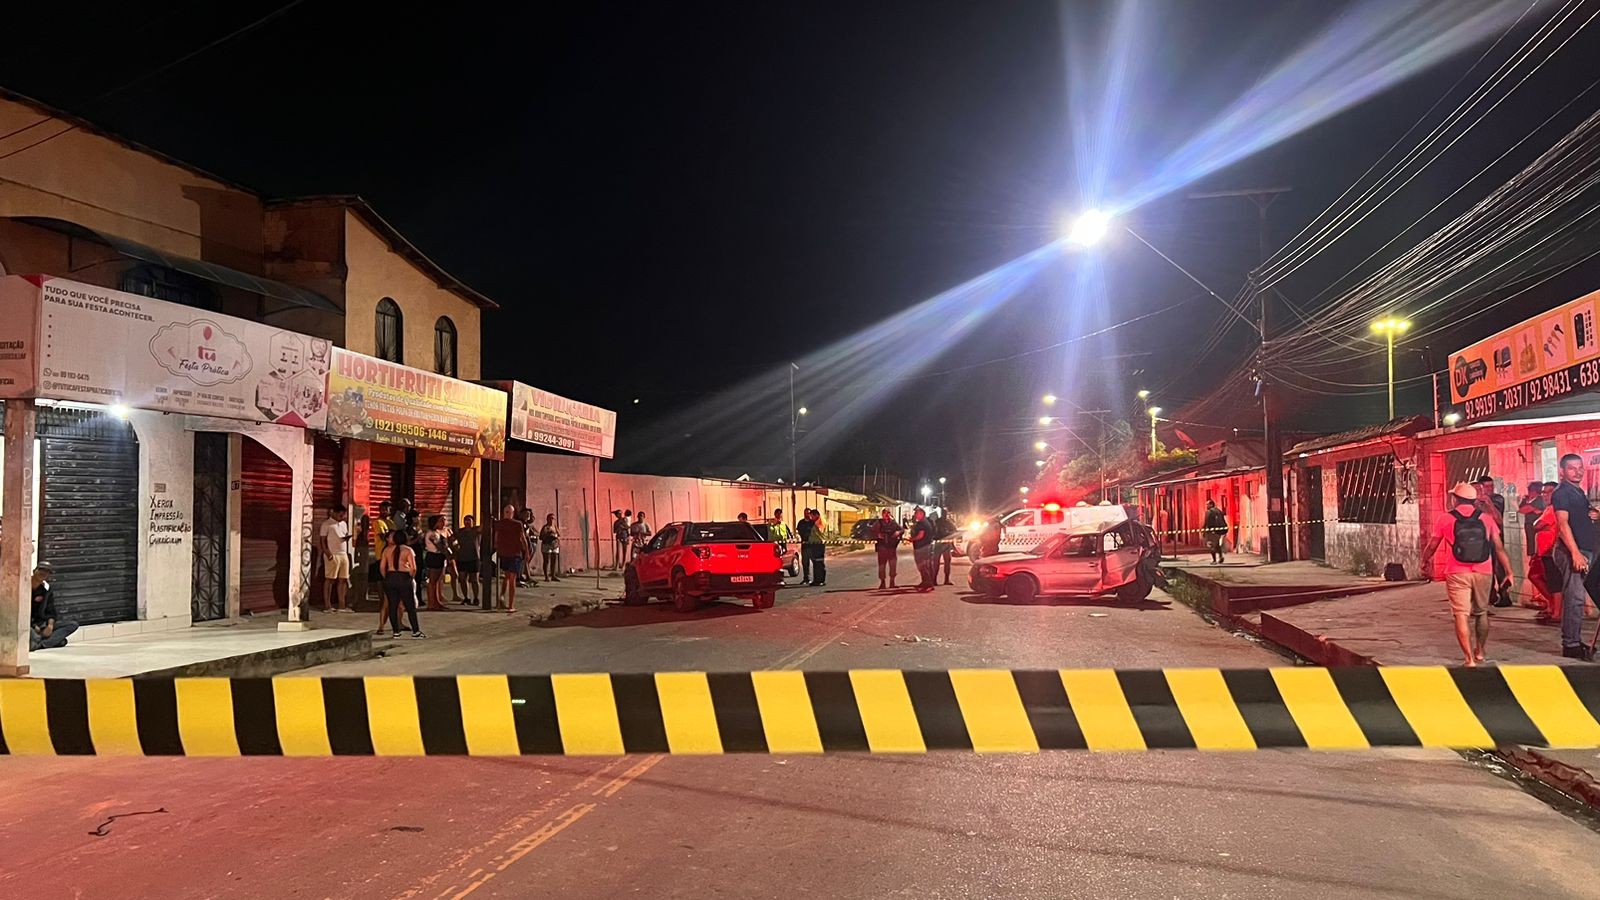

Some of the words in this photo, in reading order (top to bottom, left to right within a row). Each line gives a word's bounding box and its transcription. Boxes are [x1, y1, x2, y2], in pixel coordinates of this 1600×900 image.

[44, 294, 66, 305] PARA
[68, 299, 84, 308] SUA
[85, 302, 107, 313] FESTA
[109, 308, 155, 322] ACONTECER.
[45, 285, 68, 296] TUDO
[70, 290, 87, 300] QUE
[88, 294, 109, 305] VOCÊ
[110, 299, 141, 311] PRECISA
[179, 359, 198, 371] Festa
[201, 362, 229, 375] Prática
[336, 352, 442, 399] HORTIFRUTI
[1465, 401, 1474, 420] 92
[1503, 385, 1522, 410] 2037
[1530, 379, 1542, 402] 92
[1542, 369, 1572, 398] 98431
[1580, 358, 1600, 387] 638
[375, 418, 394, 432] (92)
[395, 423, 447, 441] 99506-1446
[534, 431, 574, 448] 99244-3091
[150, 509, 184, 520] IMPRESSÃO
